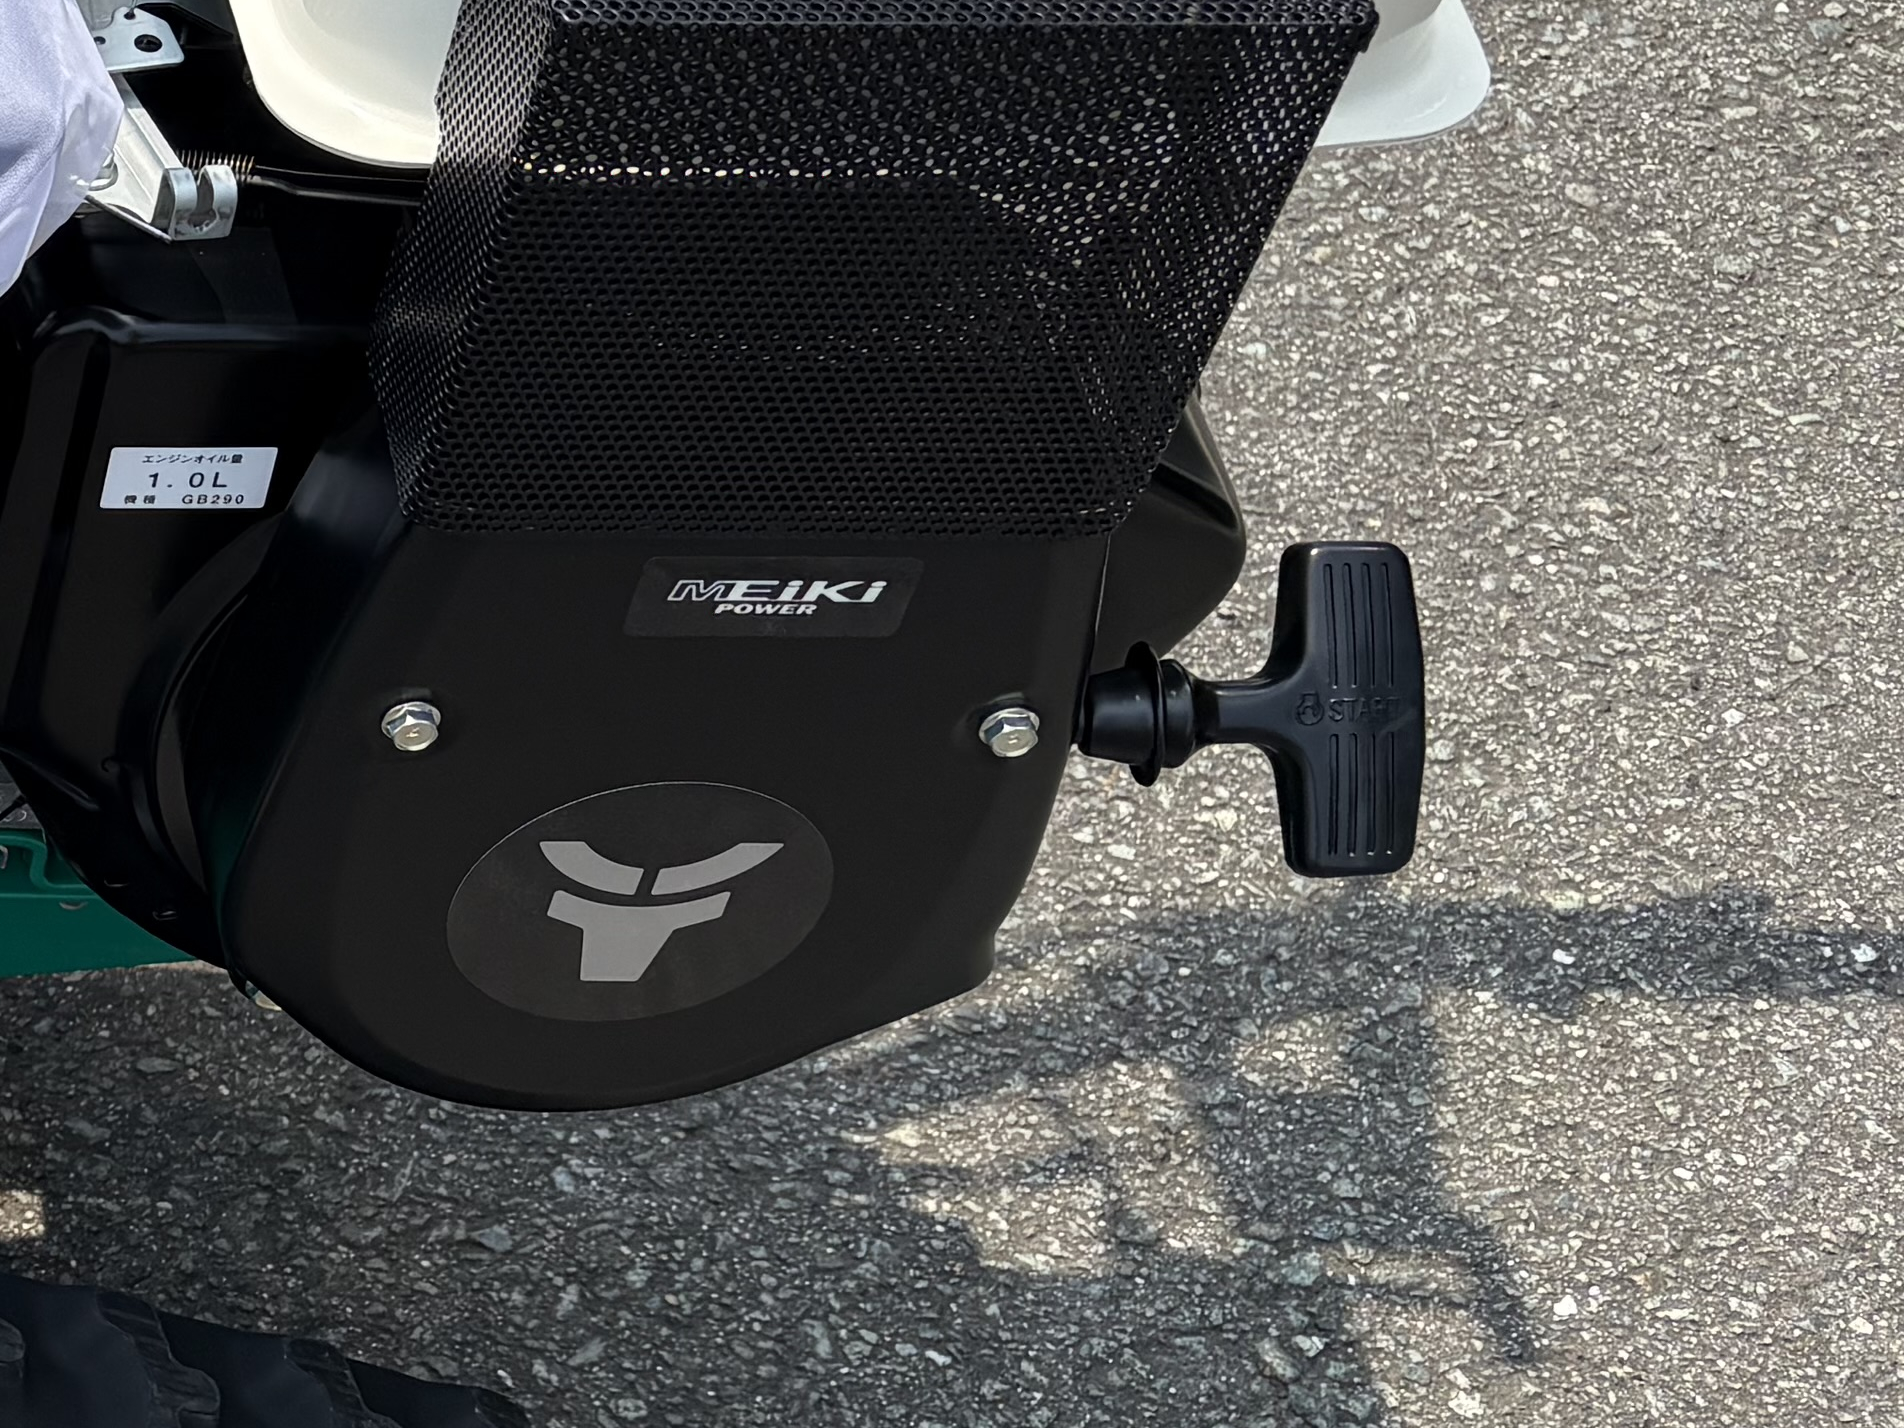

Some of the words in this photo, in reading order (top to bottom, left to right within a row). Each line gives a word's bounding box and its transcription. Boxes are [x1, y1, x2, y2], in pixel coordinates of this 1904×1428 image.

[140, 453, 243, 464] エンジンオイル量
[180, 493, 245, 505] GB290
[714, 603, 818, 615] POWER
